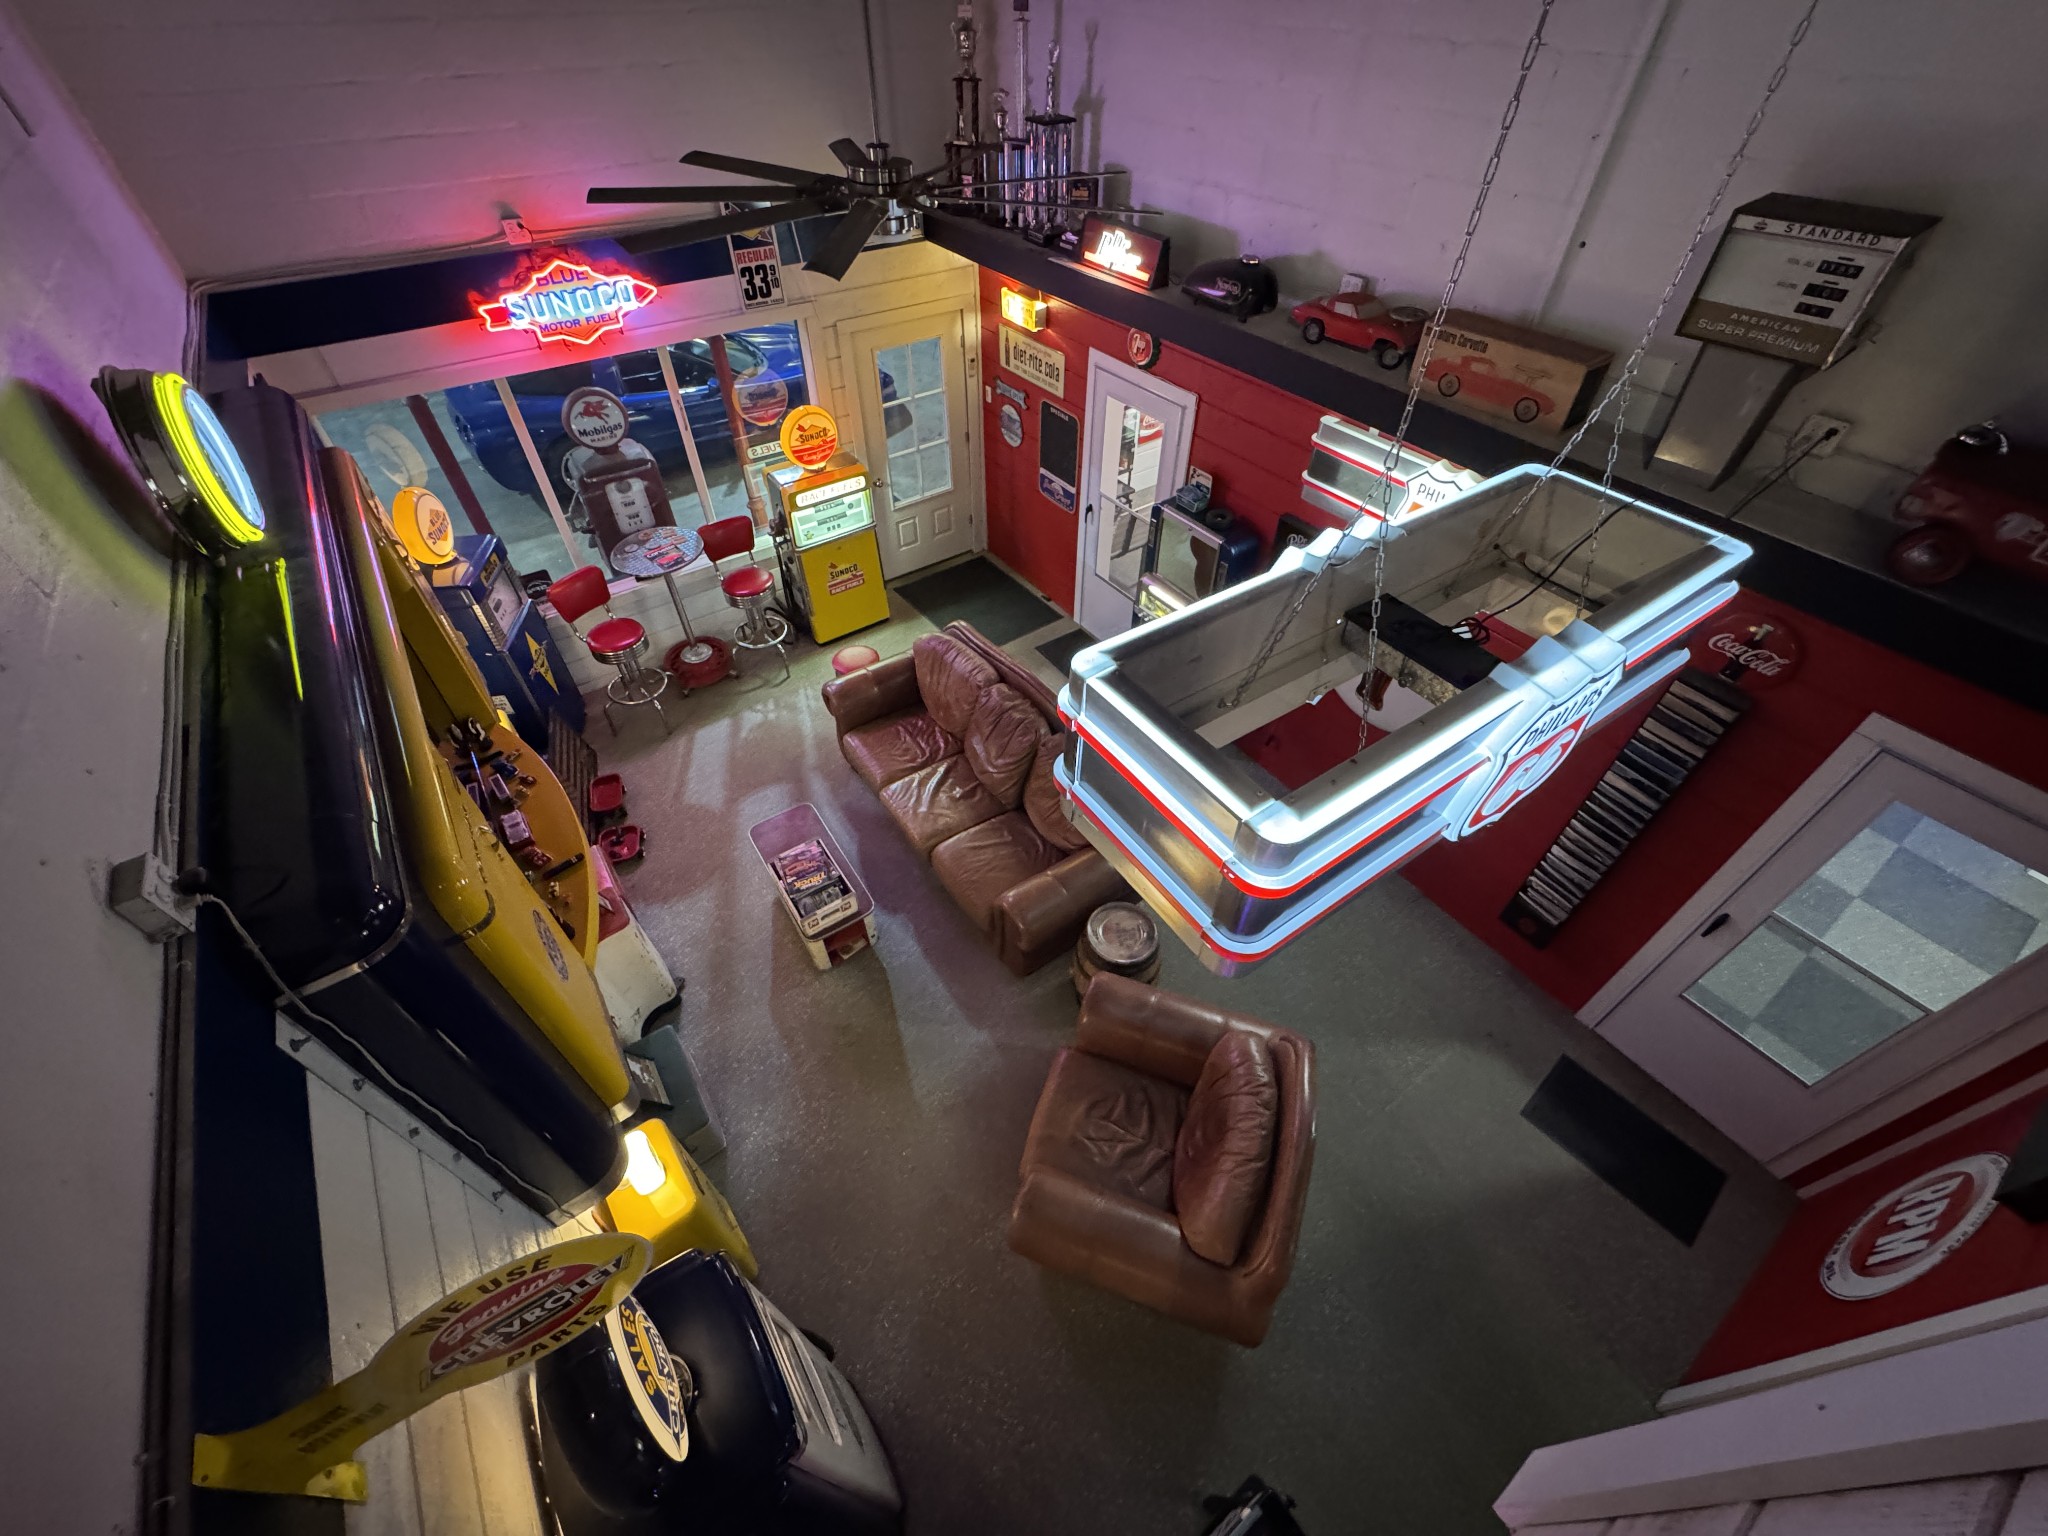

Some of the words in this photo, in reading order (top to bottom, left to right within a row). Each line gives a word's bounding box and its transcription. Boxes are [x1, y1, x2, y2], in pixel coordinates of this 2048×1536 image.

[1784, 223, 1882, 248] STANDARD
[736, 248, 775, 265] REGULAR
[537, 269, 588, 287] BLUE
[740, 264, 772, 302] 33
[504, 279, 641, 327] SUNOCO
[539, 317, 582, 334] MOTOR
[586, 313, 615, 327] FUEL
[1697, 318, 1744, 338] SUPER
[1748, 330, 1820, 355] PREMIUM
[1730, 311, 1802, 335] AMERICAN
[1044, 361, 1060, 382] cola
[577, 421, 623, 439] Mobilgas
[799, 427, 827, 444] SUNOCO
[428, 511, 450, 545] SUNOCO
[830, 563, 858, 580] SUNOCO
[1708, 633, 1791, 676] Coca-Cola
[1516, 680, 1611, 756] PHILLIPS
[1864, 1174, 1966, 1266] RPM
[410, 1298, 470, 1338] WE
[477, 1253, 553, 1295] USE
[439, 1268, 567, 1346] Genuine
[430, 1255, 624, 1380] CHEVROLET
[506, 1303, 608, 1368] PARTS
[620, 1304, 657, 1397] SALES
